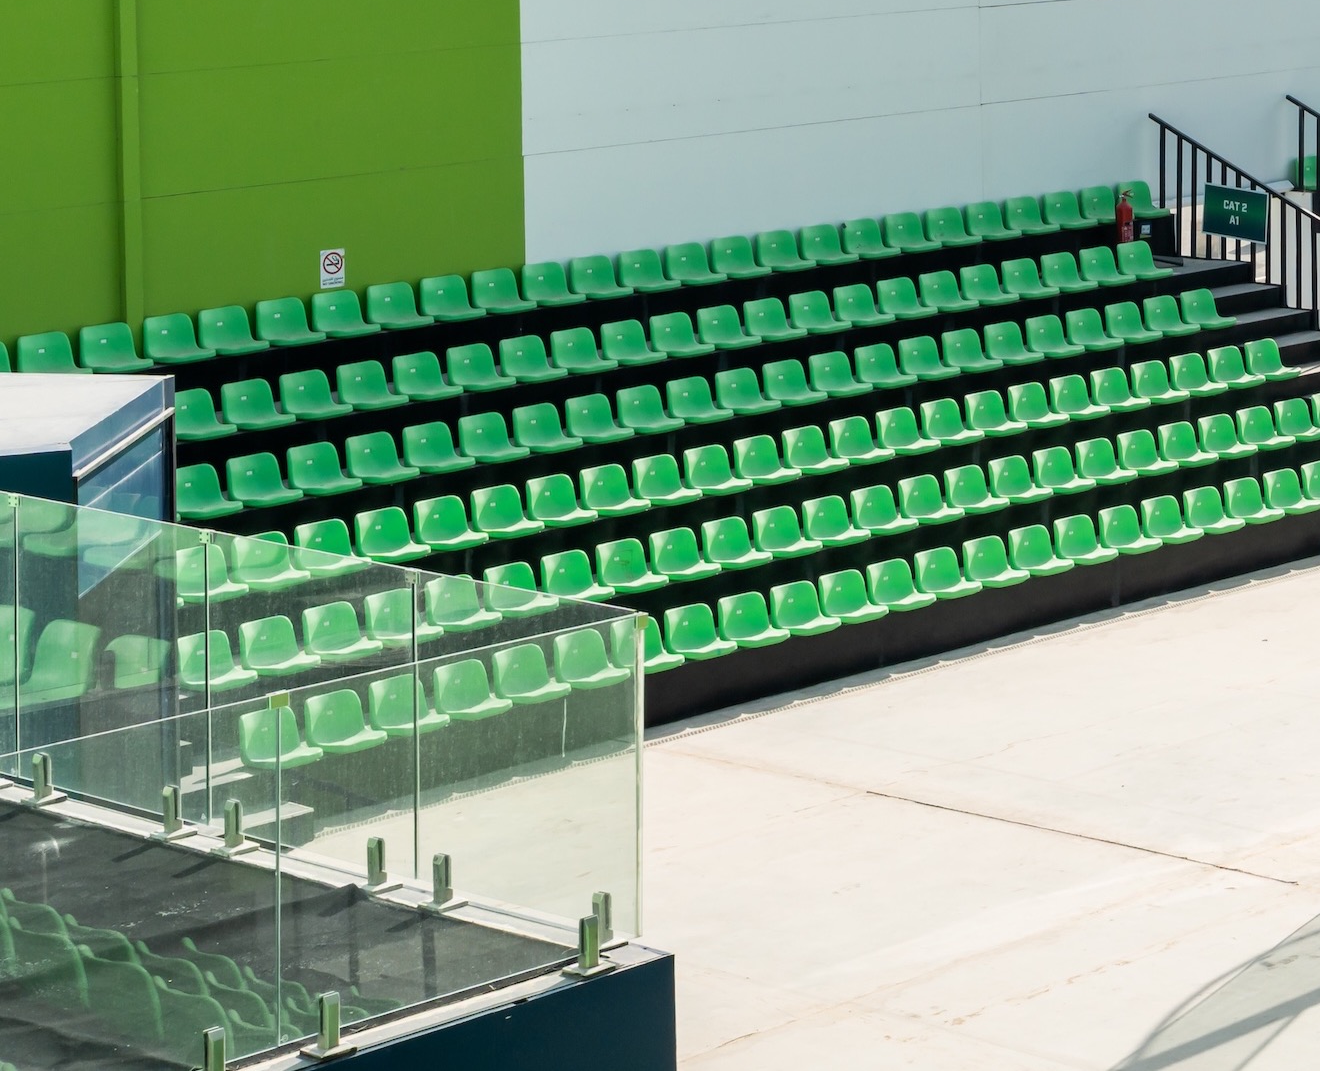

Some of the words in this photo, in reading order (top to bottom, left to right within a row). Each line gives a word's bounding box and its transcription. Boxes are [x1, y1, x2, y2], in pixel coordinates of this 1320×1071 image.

[1224, 200, 1240, 211] CAT
[1242, 203, 1247, 212] 2
[1229, 215, 1239, 225] A1
